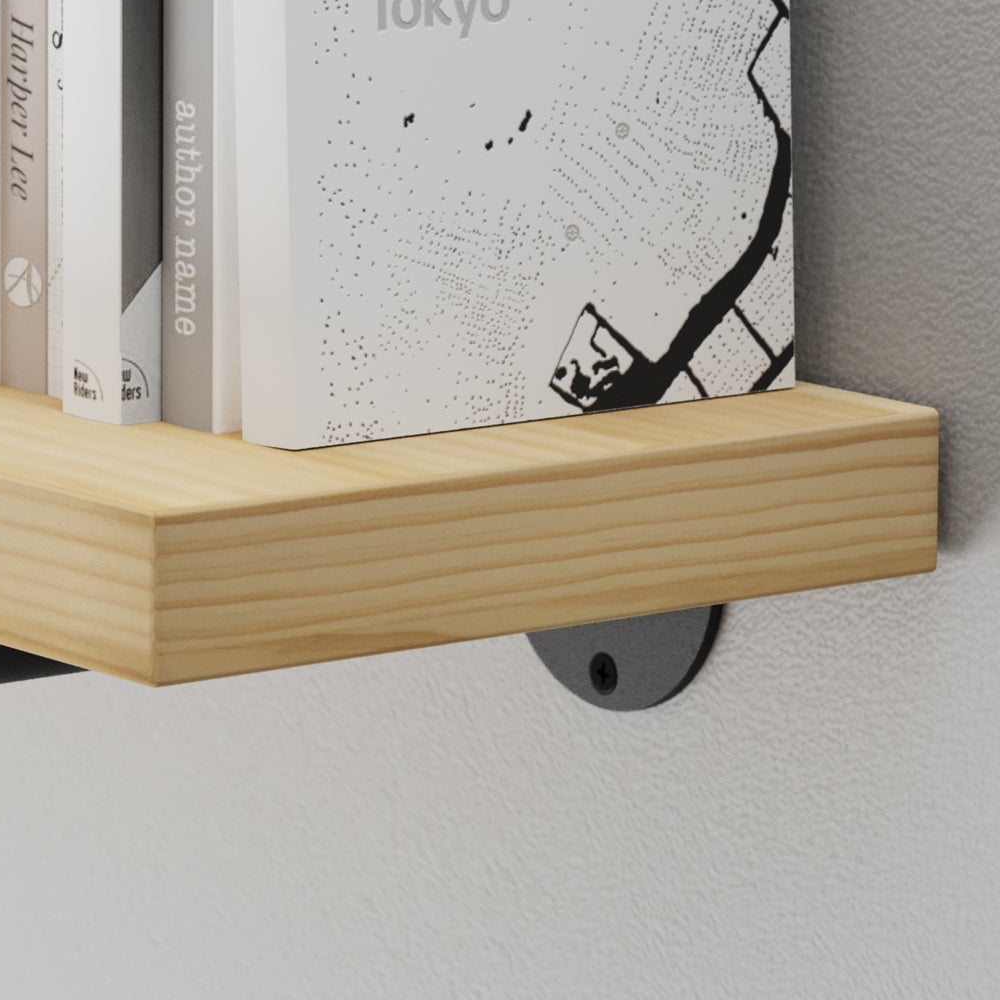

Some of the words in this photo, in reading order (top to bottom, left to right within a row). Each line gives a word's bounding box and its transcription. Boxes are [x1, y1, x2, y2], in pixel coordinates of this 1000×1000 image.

[7, 15, 34, 138] Harper
[10, 143, 34, 202] Lee
[175, 99, 203, 227] author
[175, 235, 197, 337] name
